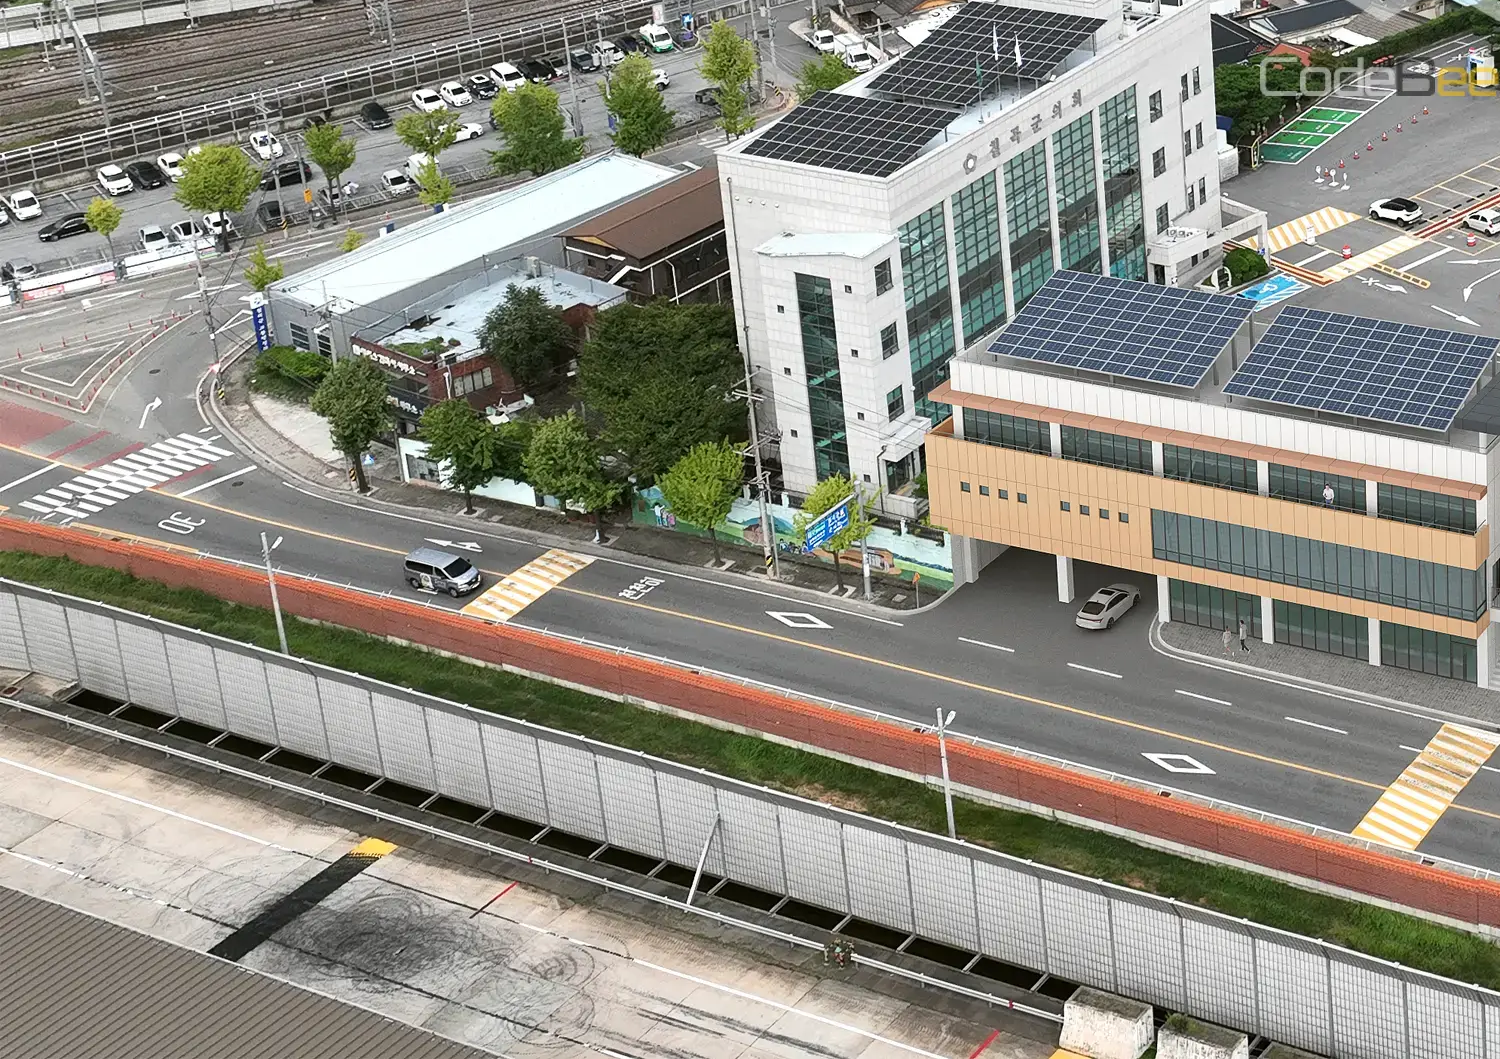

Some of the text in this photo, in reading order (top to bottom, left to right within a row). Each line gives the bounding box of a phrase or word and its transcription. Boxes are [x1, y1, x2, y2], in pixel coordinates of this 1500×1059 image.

[989, 88, 1083, 158] 칠곡군의회
[158, 511, 206, 535] 30
[618, 576, 666, 601] 천천히
